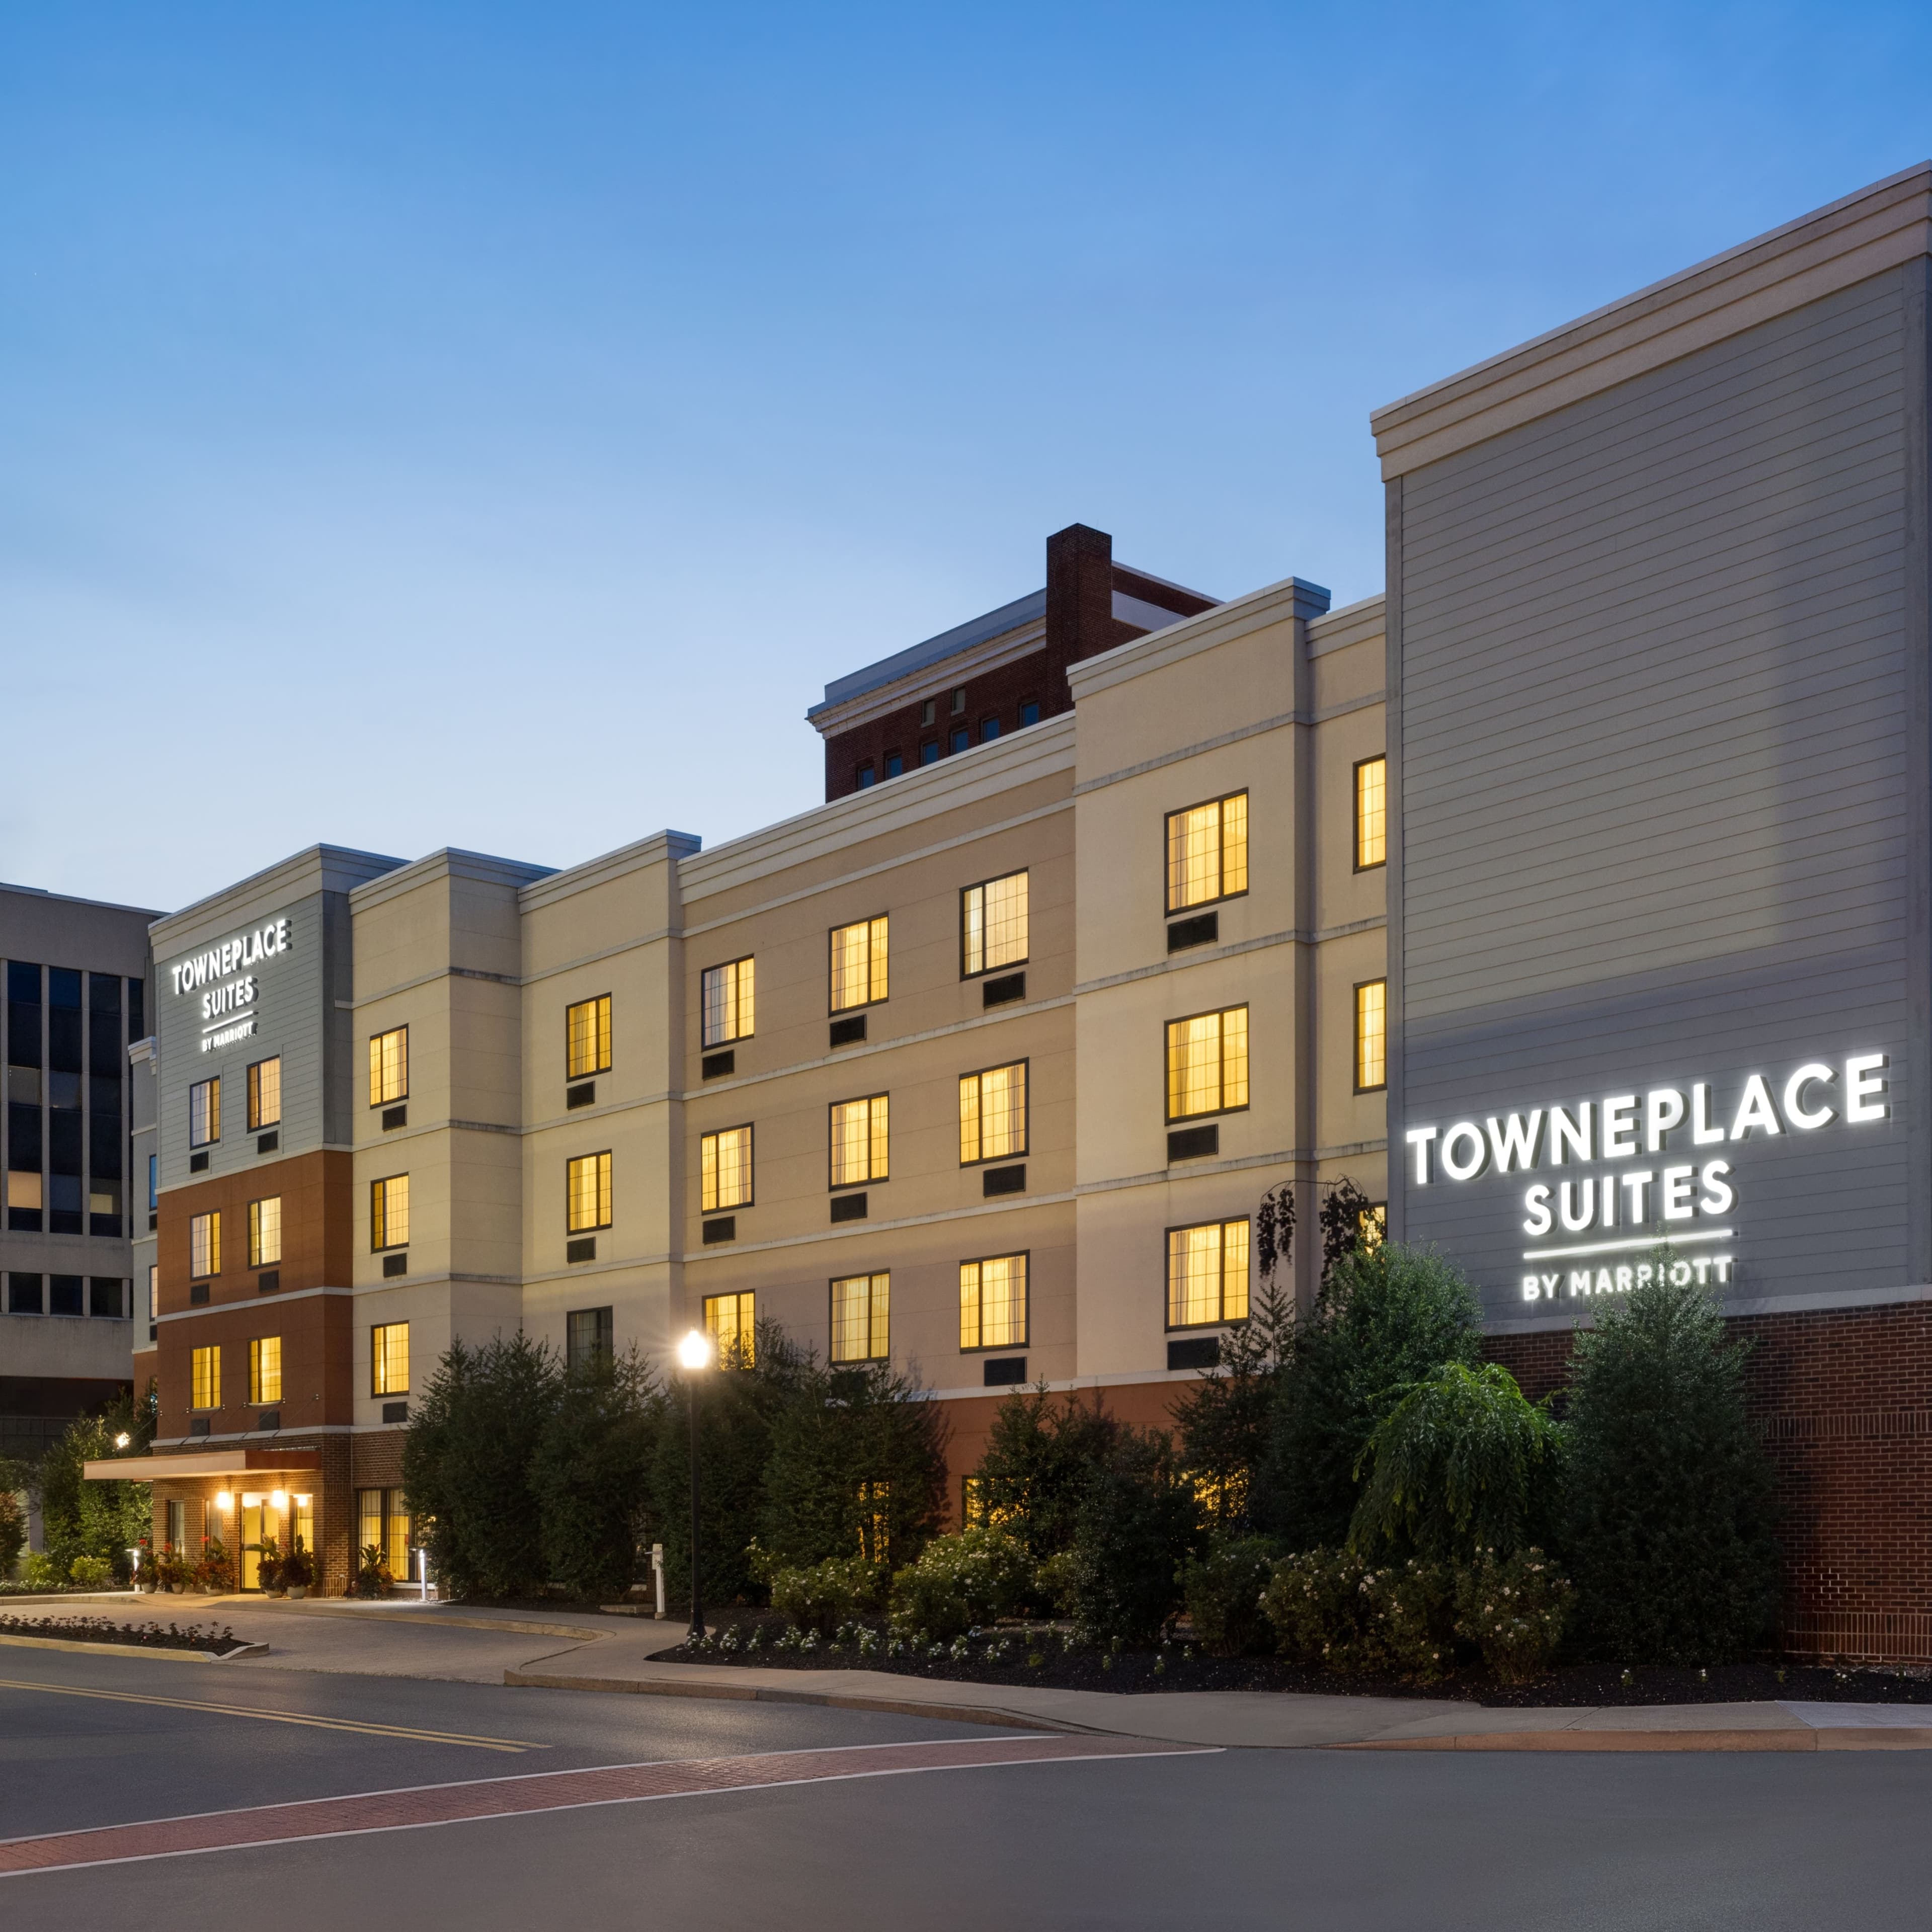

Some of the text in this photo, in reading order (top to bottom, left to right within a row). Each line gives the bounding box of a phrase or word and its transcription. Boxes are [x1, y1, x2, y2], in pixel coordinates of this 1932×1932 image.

[172, 919, 287, 995] TOWNEPLACE
[202, 976, 254, 1019] SUITES
[202, 1021, 254, 1052] BY MARRIOTT
[1406, 1054, 1886, 1184] TOWNEPLACE
[1523, 1160, 1733, 1236] SUITES
[1523, 1274, 1559, 1301] BY
